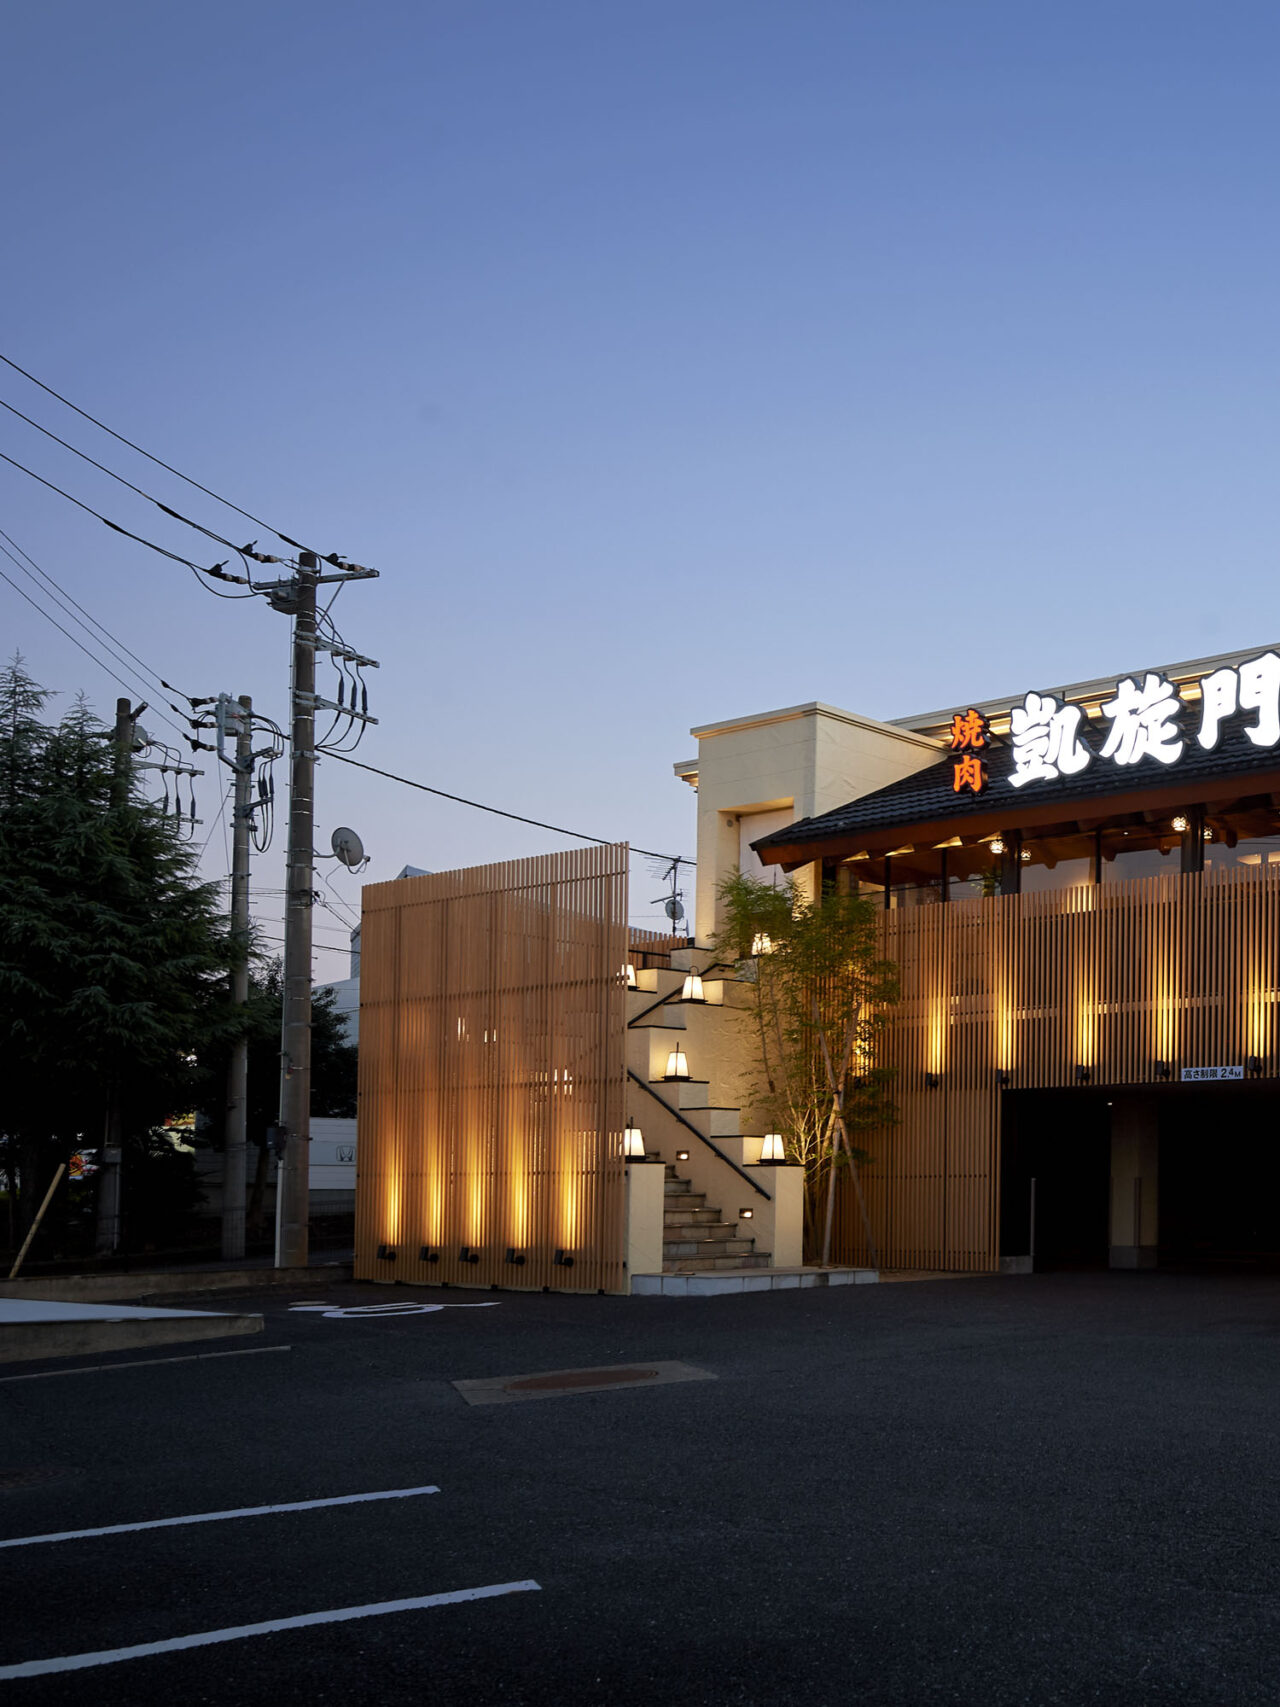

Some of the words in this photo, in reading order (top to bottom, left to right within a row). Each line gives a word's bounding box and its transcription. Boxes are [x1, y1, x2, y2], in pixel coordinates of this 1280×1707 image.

[951, 709, 984, 793] 焼肉
[1183, 1068, 1218, 1080] 高さ制限
